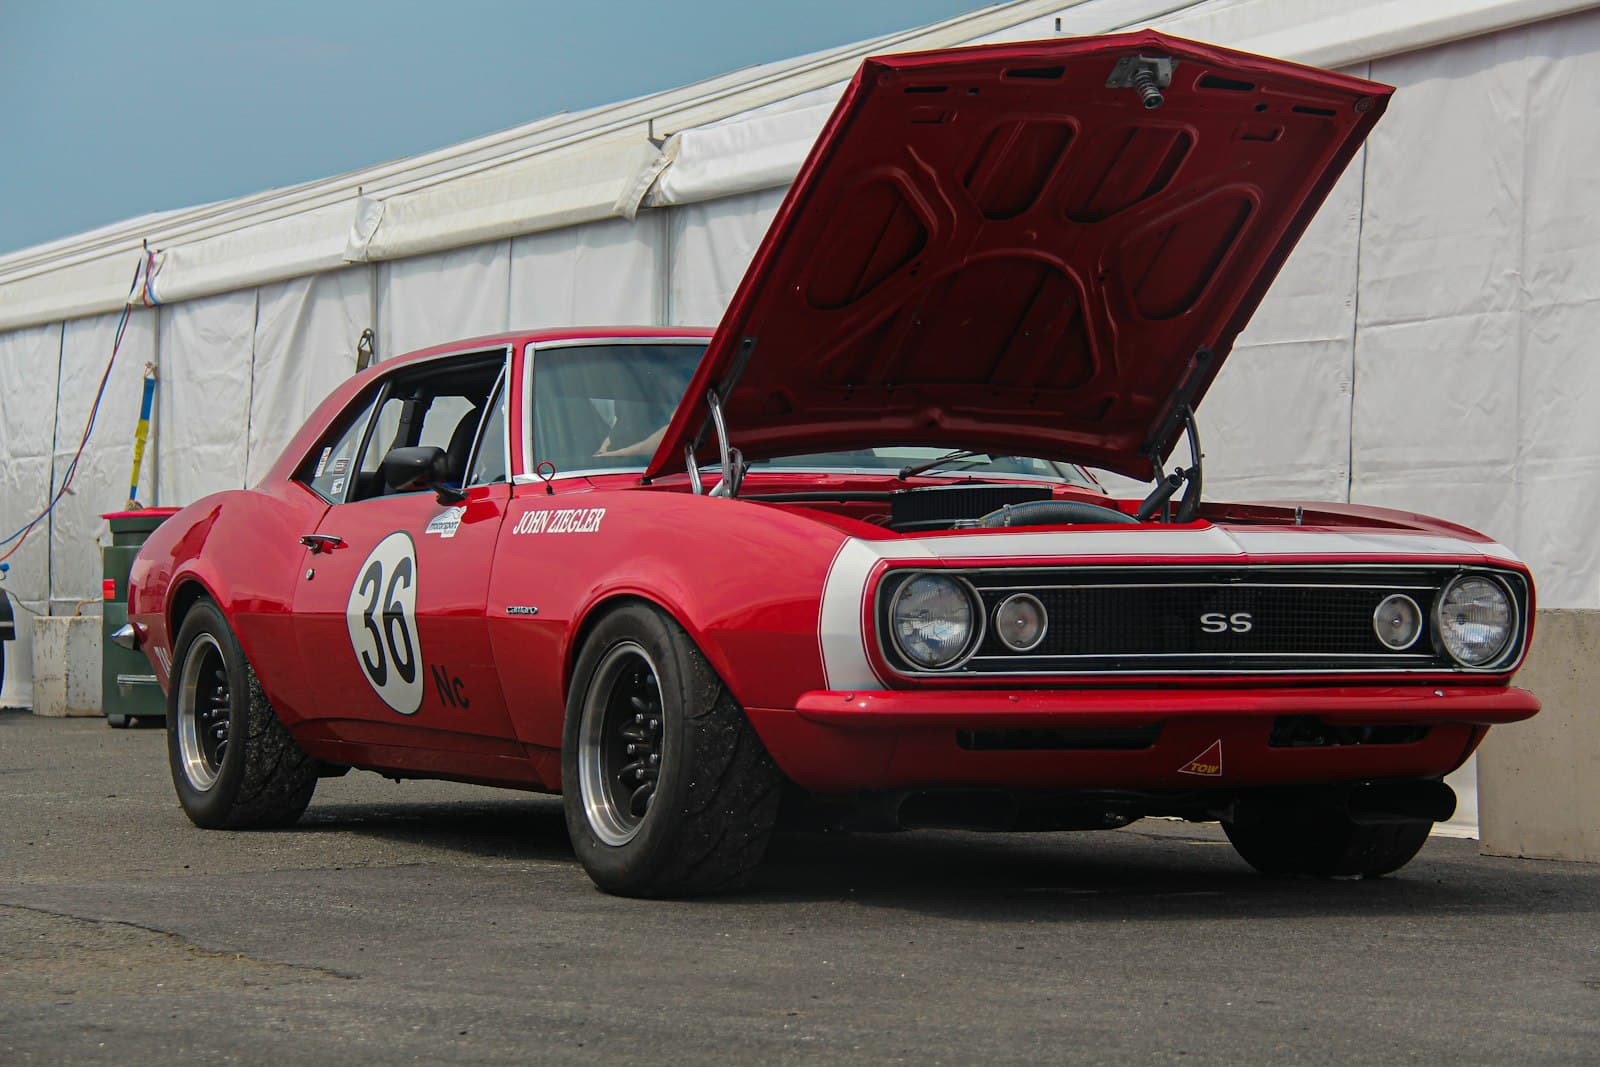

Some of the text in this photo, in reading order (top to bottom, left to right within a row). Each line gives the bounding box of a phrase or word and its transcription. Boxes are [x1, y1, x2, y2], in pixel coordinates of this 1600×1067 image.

[512, 508, 606, 535] JOHN ZIEGLER
[358, 556, 416, 687] 36
[1200, 612, 1252, 633] SS
[431, 663, 470, 710] Nc
[1191, 762, 1219, 774] TOW
